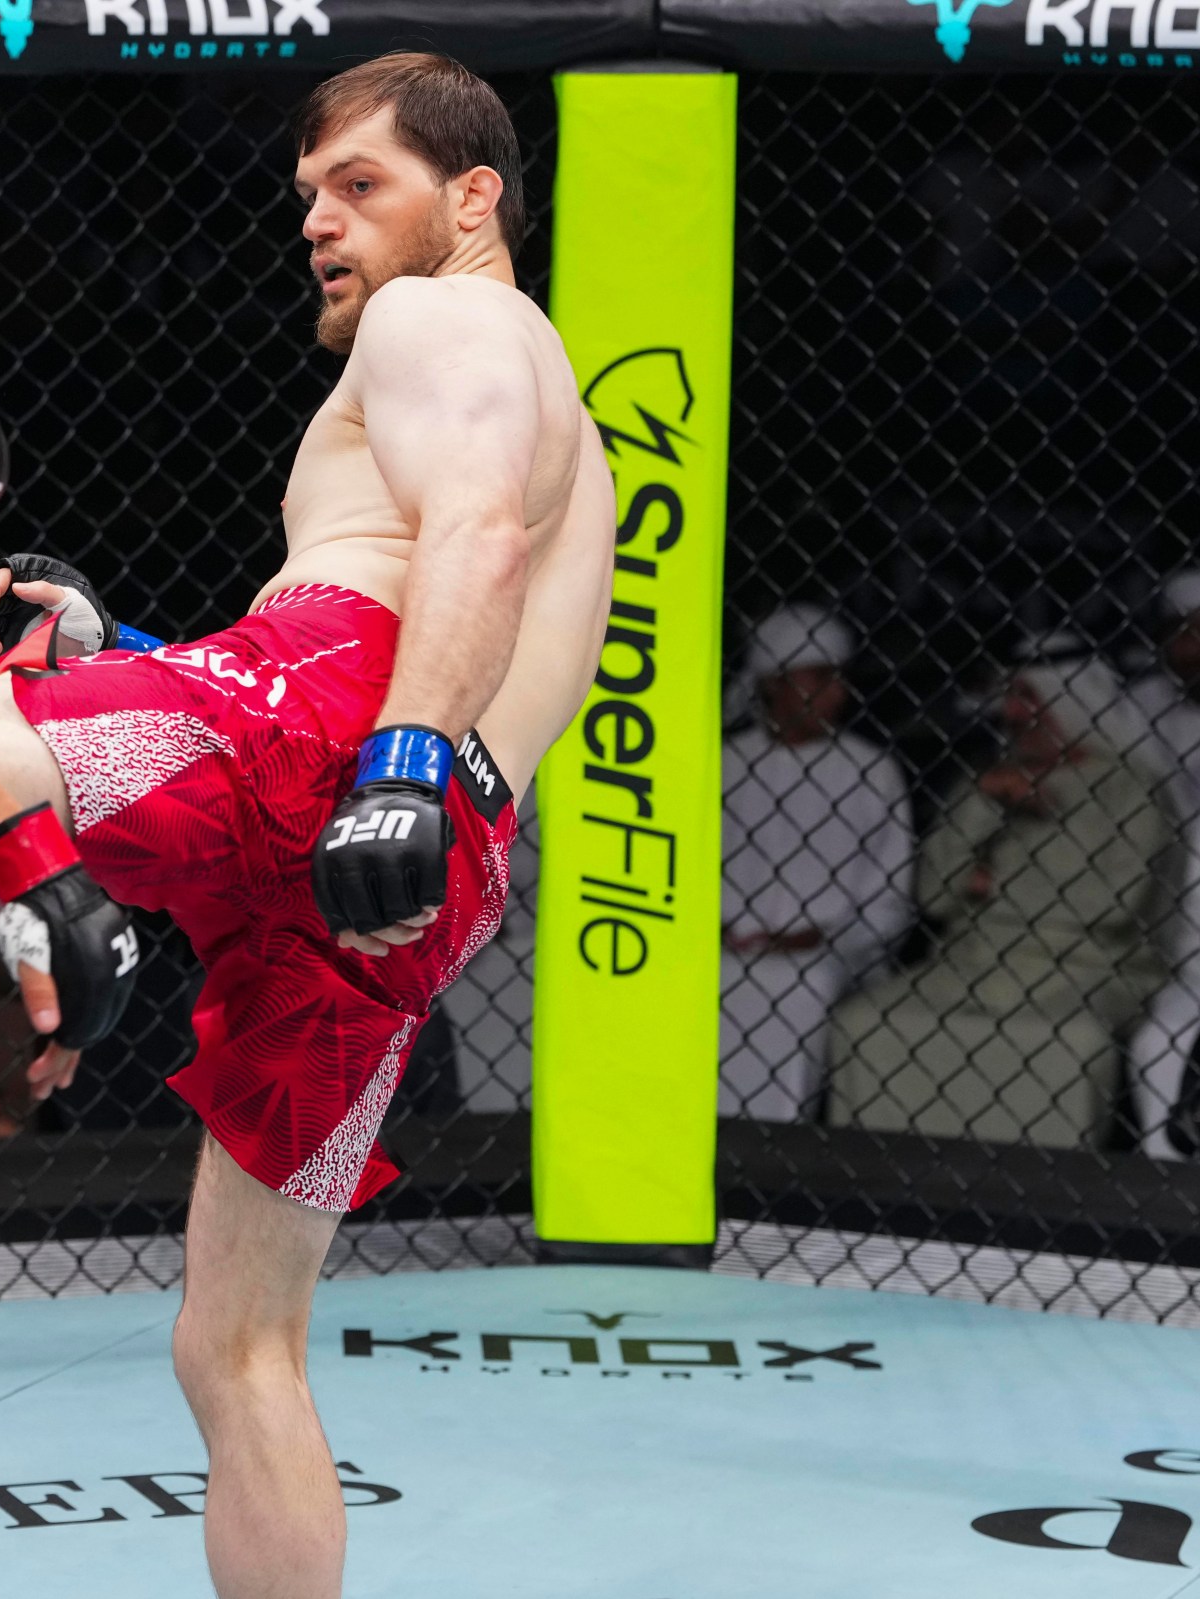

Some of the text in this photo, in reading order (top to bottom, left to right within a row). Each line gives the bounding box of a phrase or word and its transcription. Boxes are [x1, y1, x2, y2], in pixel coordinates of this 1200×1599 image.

[120, 42, 297, 60] HYDRATE
[325, 809, 418, 851] UFC
[343, 1329, 884, 1370] KNOX
